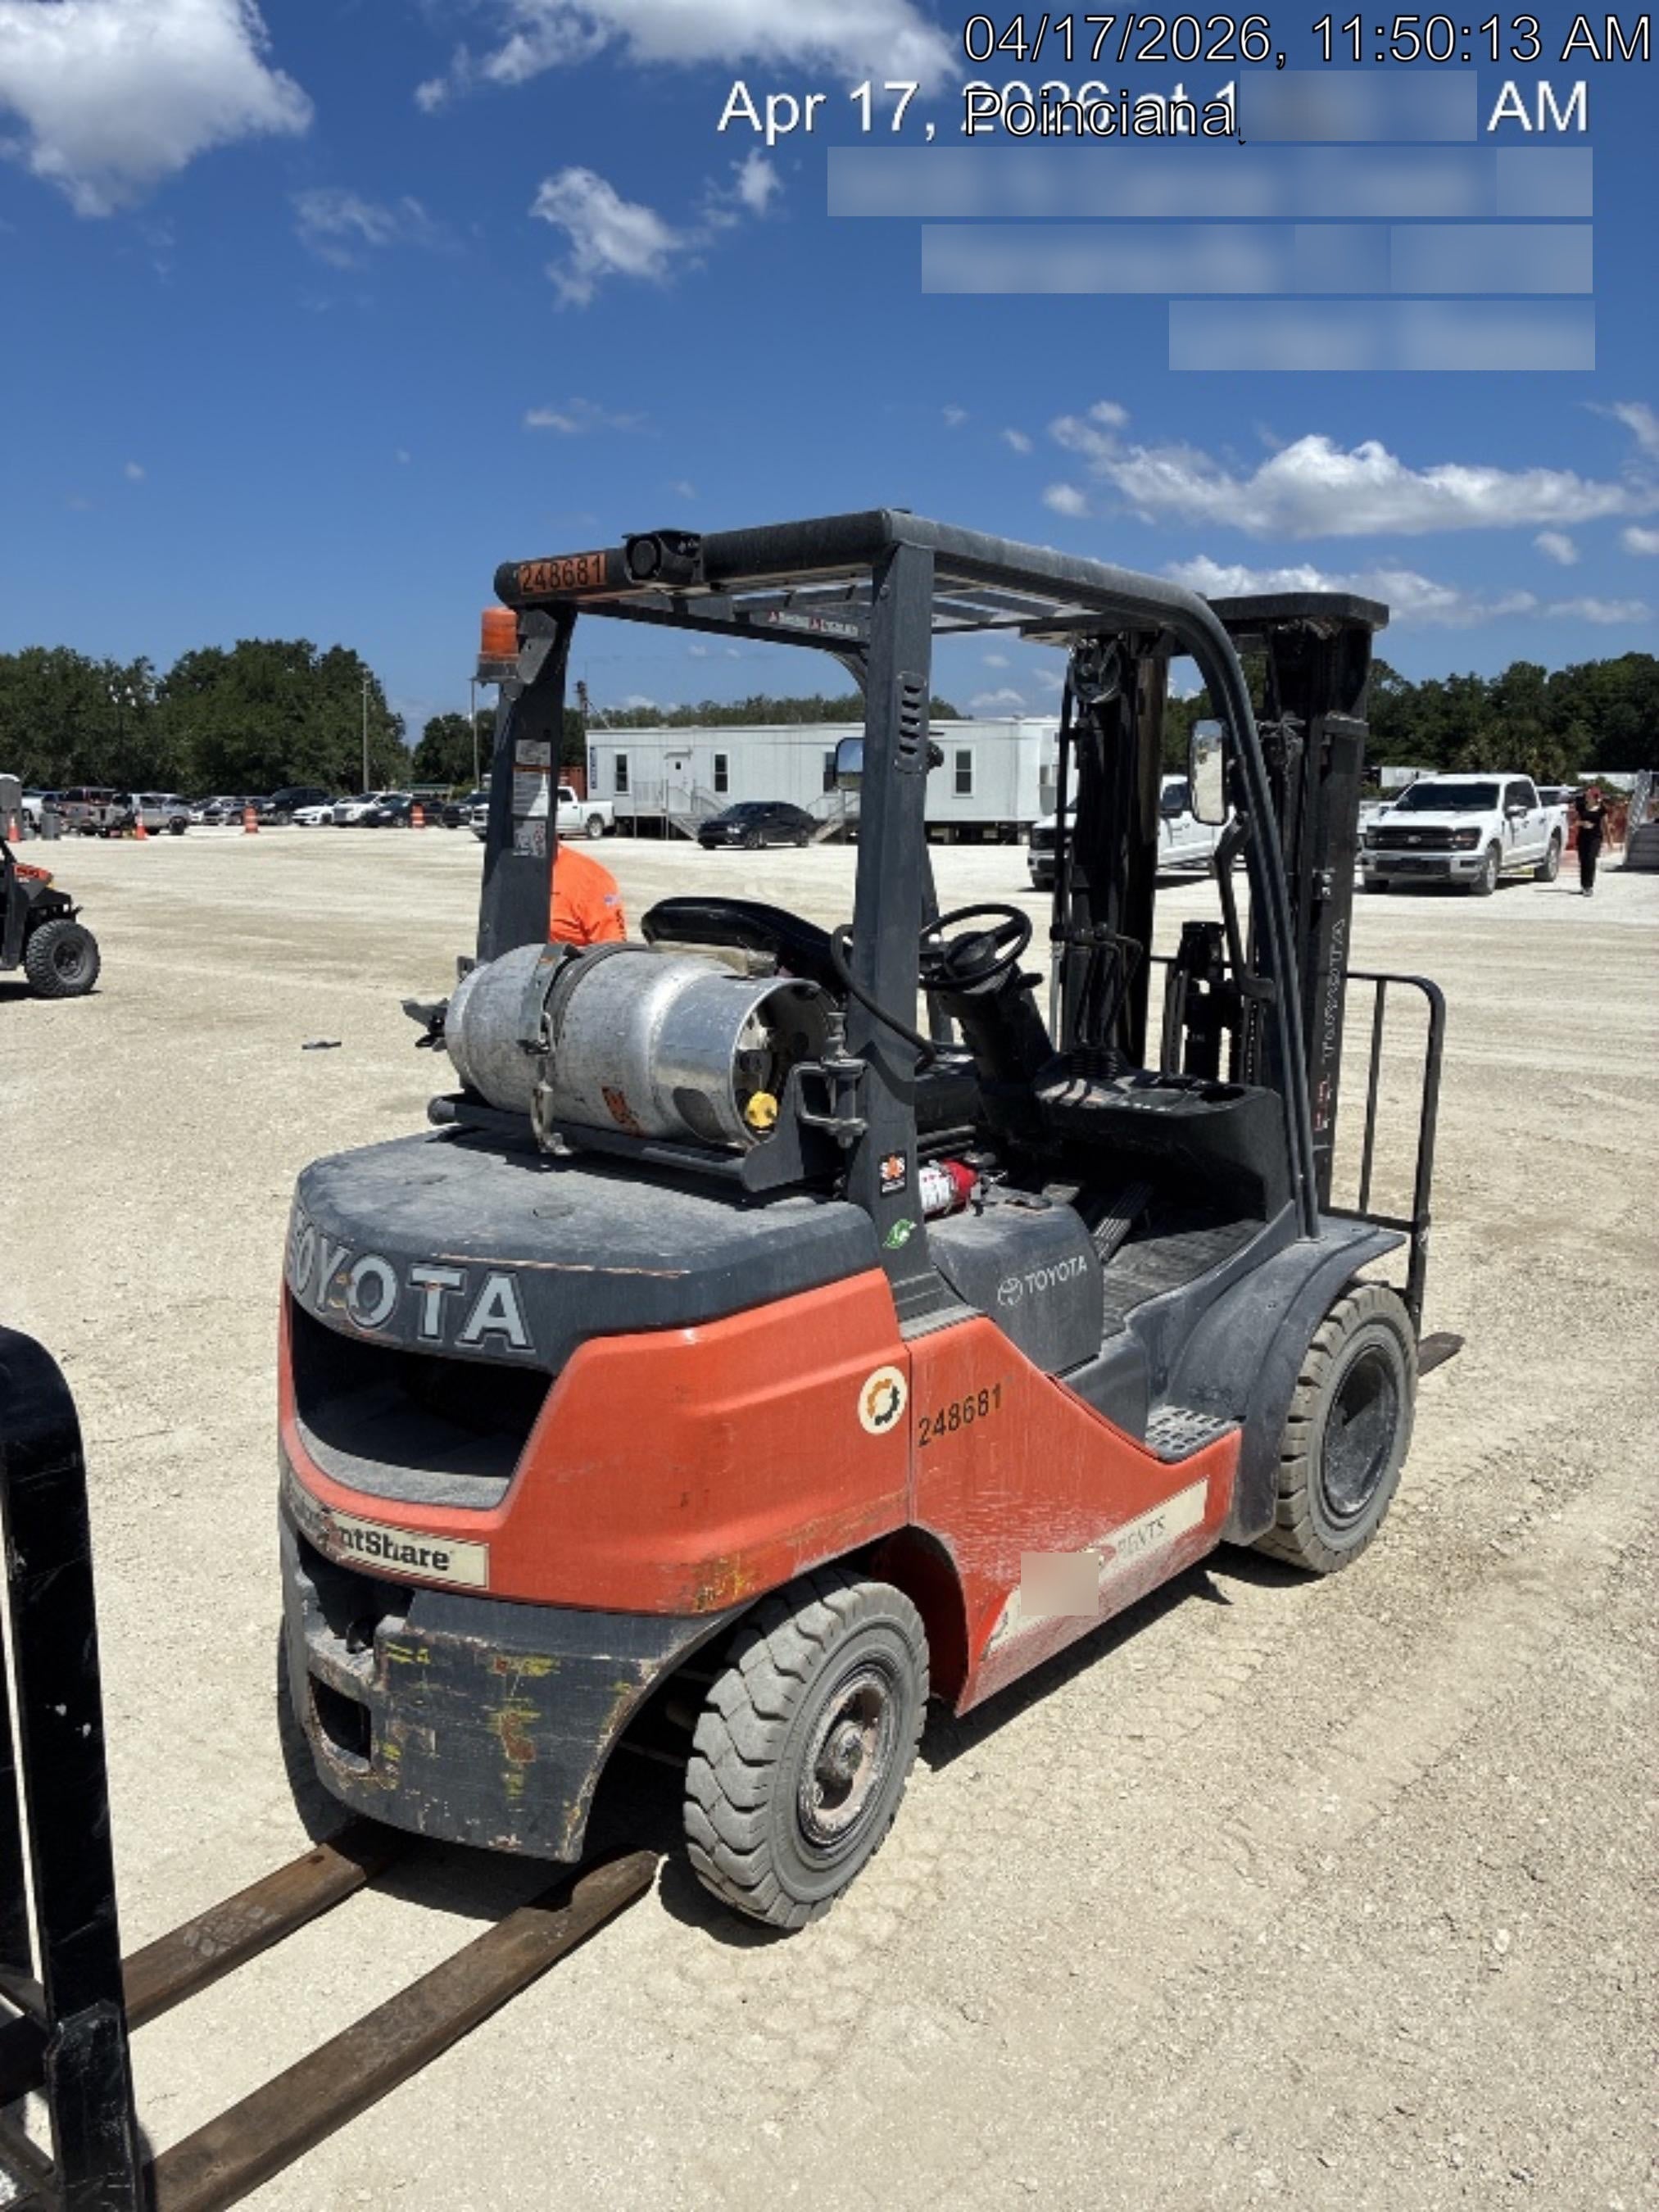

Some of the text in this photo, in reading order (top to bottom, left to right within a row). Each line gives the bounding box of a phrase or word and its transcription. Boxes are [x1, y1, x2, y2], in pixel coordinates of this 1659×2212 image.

[522, 555, 601, 592] 248681
[1023, 1254, 1088, 1294] TOYOTA
[918, 1383, 1001, 1448] 248681
